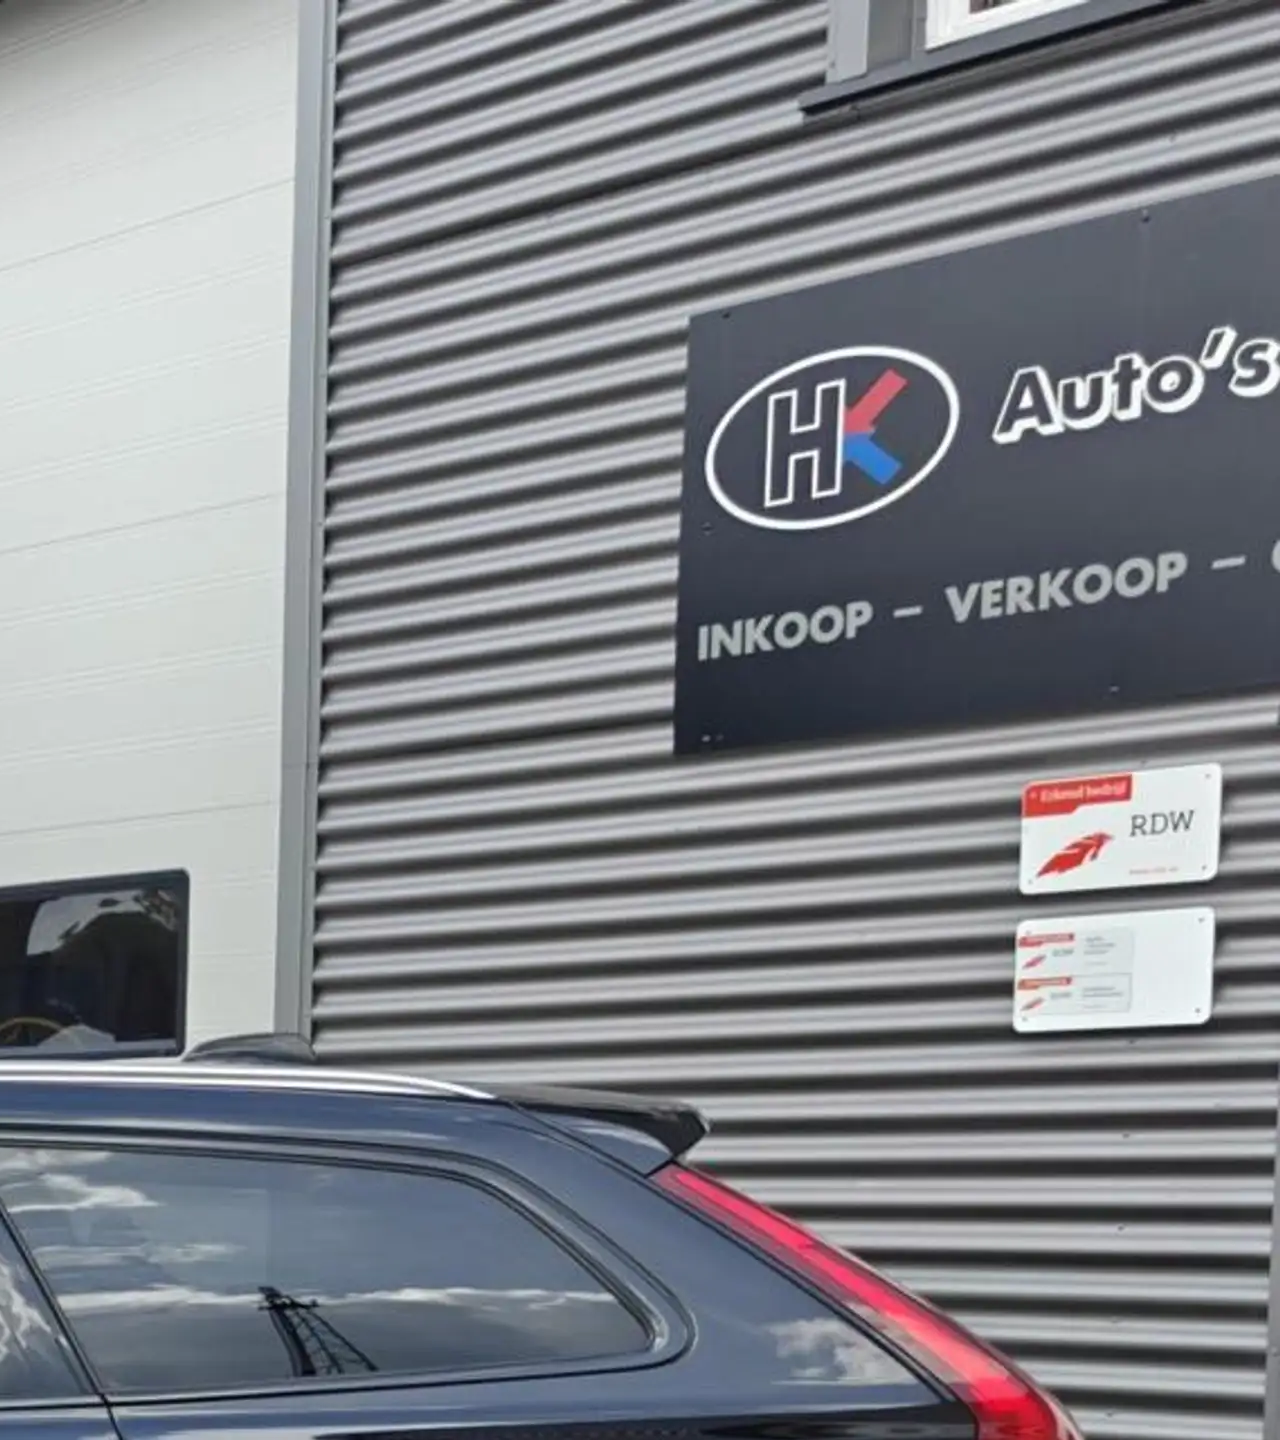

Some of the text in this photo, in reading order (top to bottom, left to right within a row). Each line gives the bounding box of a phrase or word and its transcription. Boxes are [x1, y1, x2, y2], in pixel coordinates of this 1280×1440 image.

[764, 368, 908, 507] HK
[992, 326, 1280, 444] Auto's
[697, 600, 873, 661] INKOOP
[945, 552, 1188, 622] VERKOOP
[1129, 810, 1195, 837] RDW
